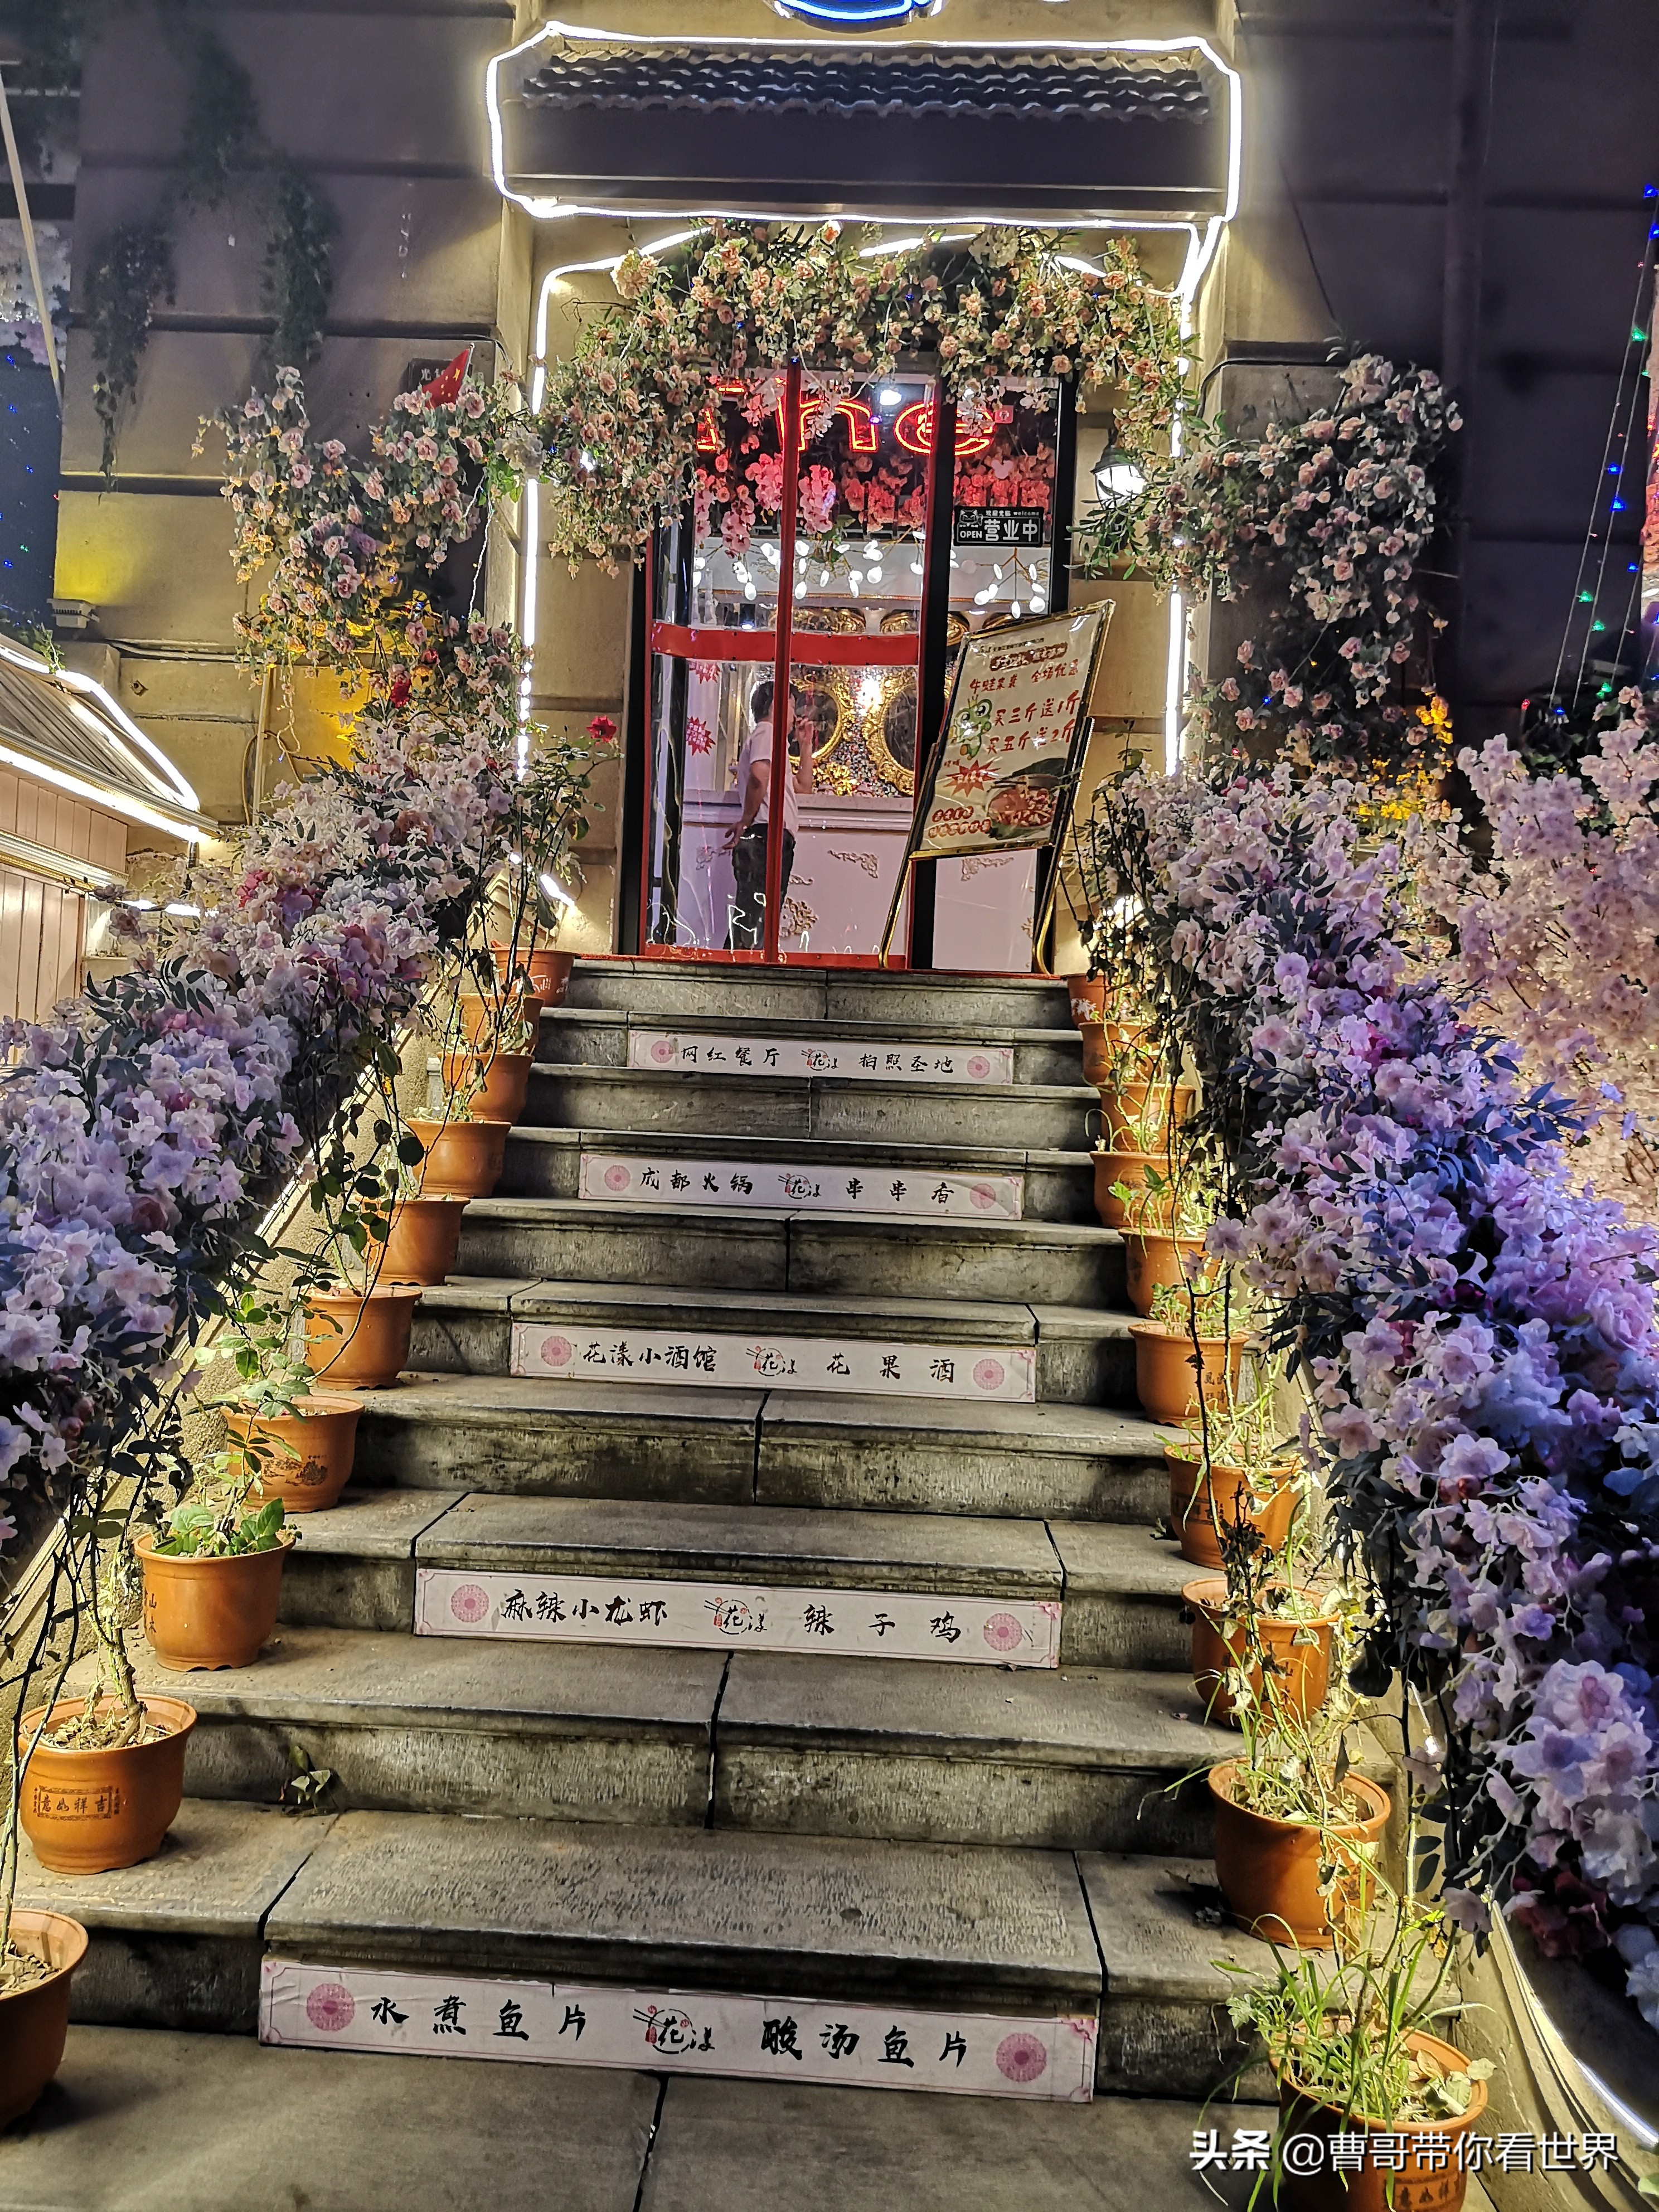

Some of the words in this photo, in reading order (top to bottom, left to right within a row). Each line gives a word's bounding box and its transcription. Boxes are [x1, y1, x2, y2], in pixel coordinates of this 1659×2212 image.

[959, 530, 982, 539] OPEN
[984, 518, 1038, 542] 营业中
[994, 690, 1080, 726] 买三斤送1斤
[681, 1045, 780, 1067] 网红餐厅
[859, 1053, 954, 1074] 拍照圣地
[640, 1167, 753, 1195] 成都火锅
[846, 1177, 954, 1204] 串串香
[583, 1341, 717, 1372] 花漾小酒馆
[826, 1352, 955, 1383] 花果酒
[502, 1589, 668, 1627] 麻辣小龙虾
[803, 1604, 962, 1643] 辣子鸡
[371, 1996, 586, 2041] 水煮鱼片
[760, 2018, 969, 2068] 酸汤鱼片
